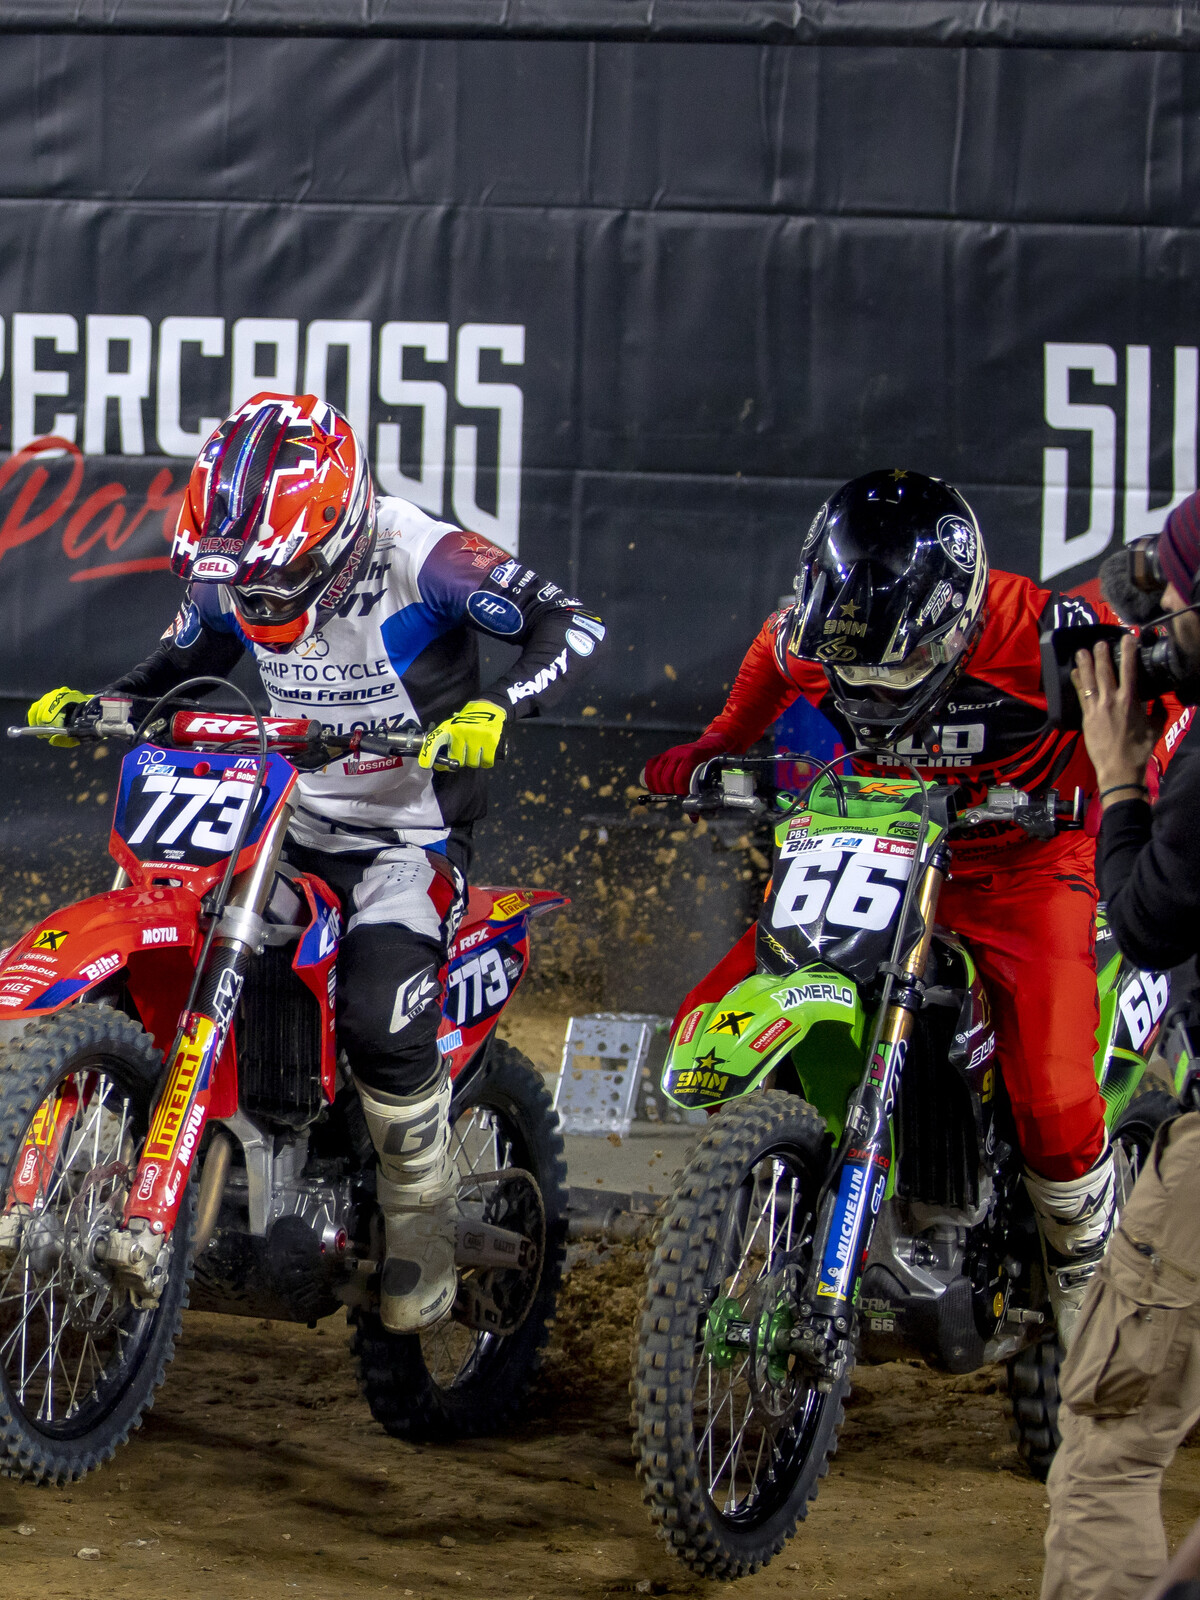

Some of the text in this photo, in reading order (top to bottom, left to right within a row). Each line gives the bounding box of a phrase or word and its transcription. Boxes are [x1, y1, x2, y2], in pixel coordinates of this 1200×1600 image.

[200, 537, 244, 552] HEXIS
[197, 562, 231, 574] BELL
[322, 534, 368, 608] HEXIS
[476, 598, 506, 616] HP
[823, 619, 868, 638] 9MM
[292, 664, 318, 682] TO
[322, 659, 389, 681] CYCLE
[317, 683, 396, 702] France
[958, 699, 1003, 711] SCOTT
[186, 718, 295, 736] RFX
[138, 751, 166, 765] DO
[236, 771, 263, 783] Bobc
[127, 775, 263, 852] 773
[789, 829, 808, 839] PBS
[787, 838, 823, 853] Bihr
[890, 844, 916, 856] Bobca
[169, 863, 200, 873] France
[771, 852, 913, 932] 66
[142, 926, 178, 944] MOTUL
[460, 927, 490, 951] RFX
[79, 953, 120, 981] Bihr
[1, 982, 34, 993] HGS
[449, 948, 509, 1027] 773
[1119, 971, 1169, 1051] 66
[753, 1019, 787, 1050] CHAMPION
[677, 1071, 730, 1093] 9MM
[146, 1050, 200, 1153] PIRELLI
[178, 1103, 206, 1167] MOTUL
[847, 1148, 891, 1169] DIMACO
[141, 1169, 156, 1195] AFAM
[836, 1167, 864, 1264] MICHELIN
[870, 1318, 894, 1330] 66
